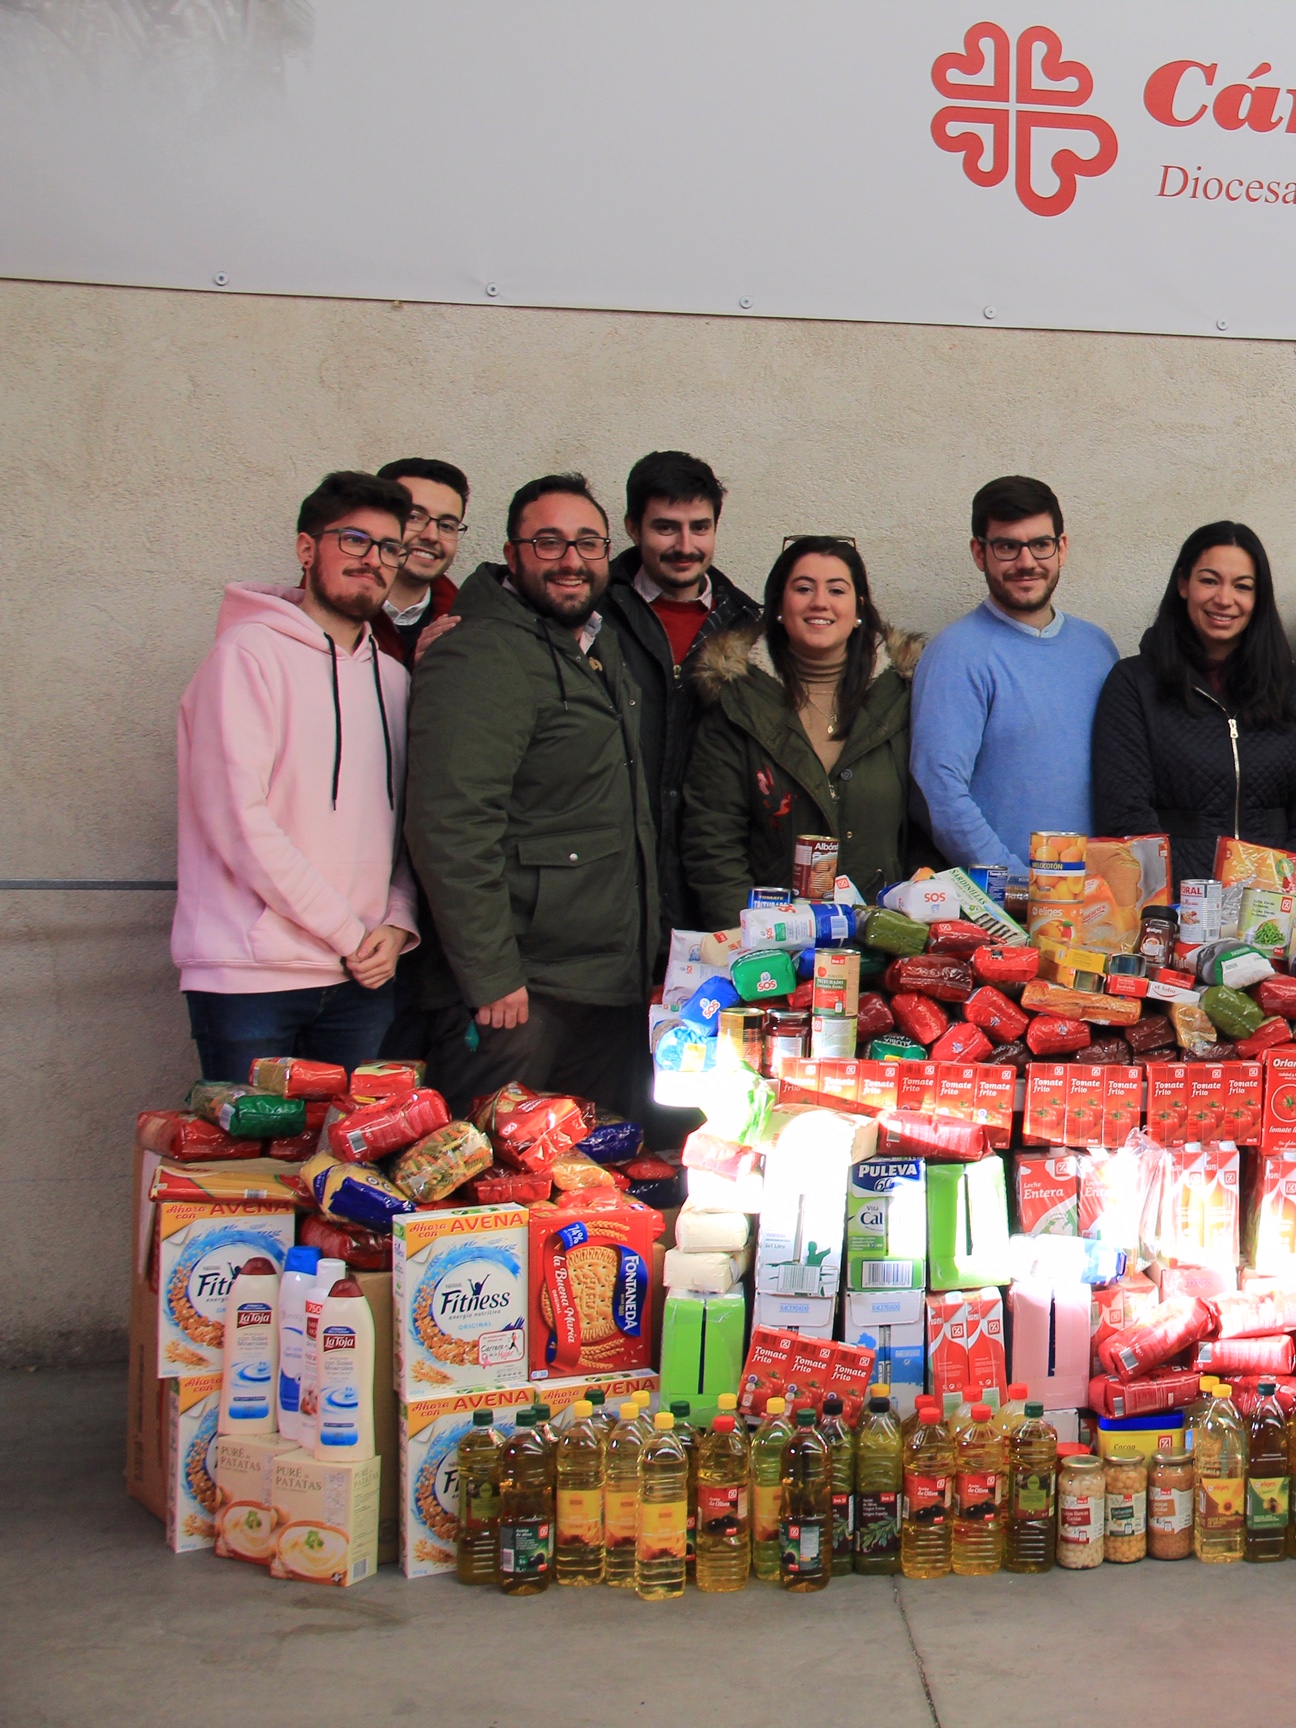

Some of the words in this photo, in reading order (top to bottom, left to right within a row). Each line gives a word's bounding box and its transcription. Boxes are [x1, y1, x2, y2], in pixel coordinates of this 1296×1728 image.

[924, 892, 946, 902] SOS
[1039, 908, 1063, 917] eliges
[758, 981, 776, 991] SOS
[704, 1001, 720, 1018] SOS
[941, 1080, 972, 1089] Tomate
[1071, 1078, 1100, 1087] Tomate
[1191, 1082, 1221, 1090] Tomate
[859, 1164, 917, 1178] PULEVA
[1023, 1188, 1064, 1200] Entera
[450, 1213, 524, 1232] AVENA
[568, 1224, 585, 1244] 74%
[553, 1255, 565, 1267] la
[554, 1268, 569, 1306] Buena
[624, 1255, 639, 1330] FONTANEDA
[440, 1289, 511, 1315] Fitness
[458, 1322, 492, 1330] ORIGINAL
[564, 1307, 576, 1343] María
[754, 1346, 788, 1361] Tomate
[454, 1390, 530, 1412] AVENA
[221, 1446, 245, 1456] PURÉ
[220, 1456, 261, 1471] PATATAS
[276, 1466, 302, 1477] PURÉ
[276, 1477, 322, 1491] PATATAS
